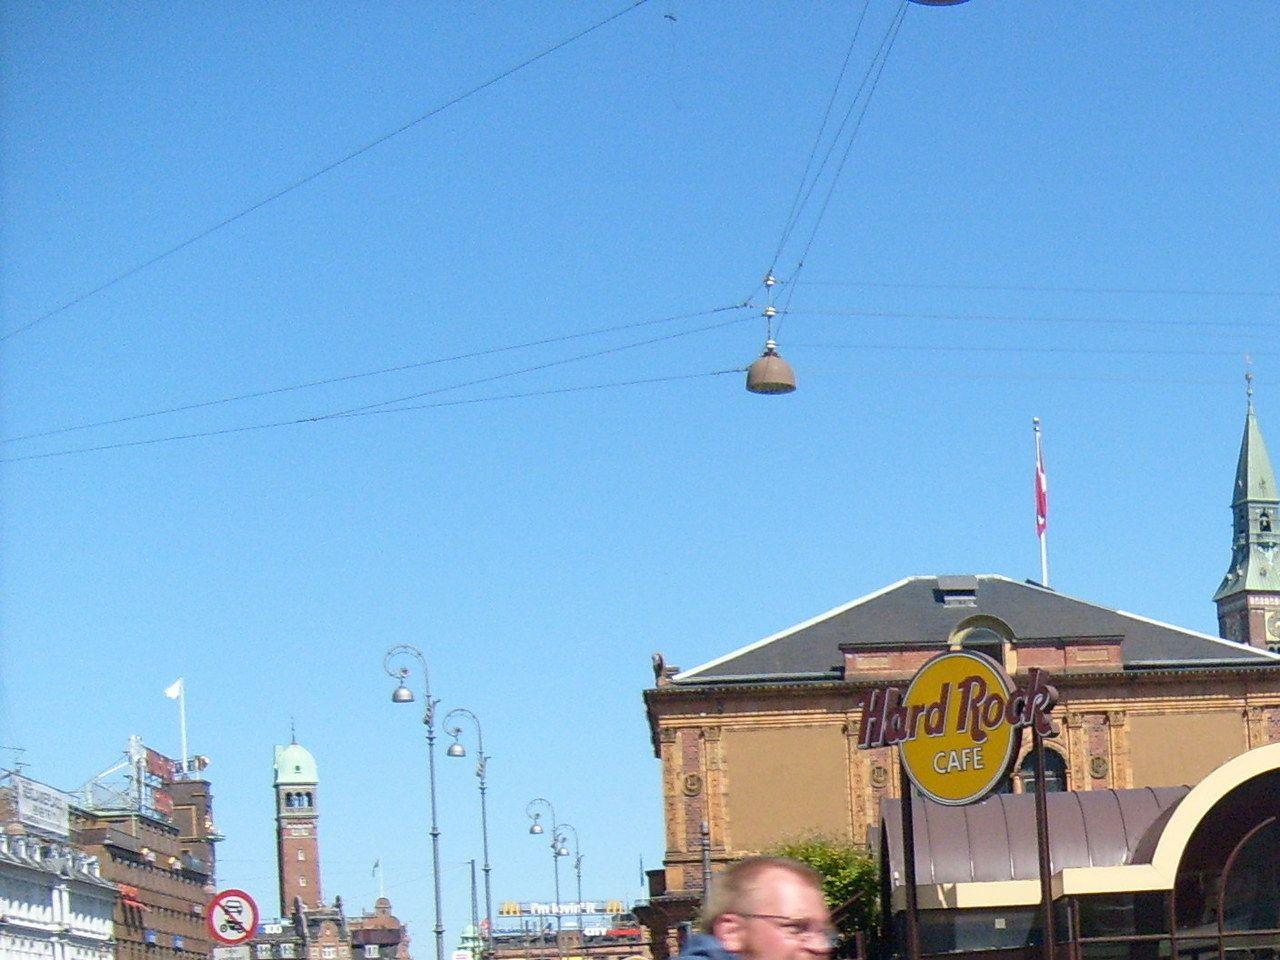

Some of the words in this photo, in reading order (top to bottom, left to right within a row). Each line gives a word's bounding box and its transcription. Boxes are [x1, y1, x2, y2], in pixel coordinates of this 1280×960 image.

[857, 682, 952, 749] Hard
[956, 667, 1060, 743] Rock
[933, 747, 984, 774] CAFE
